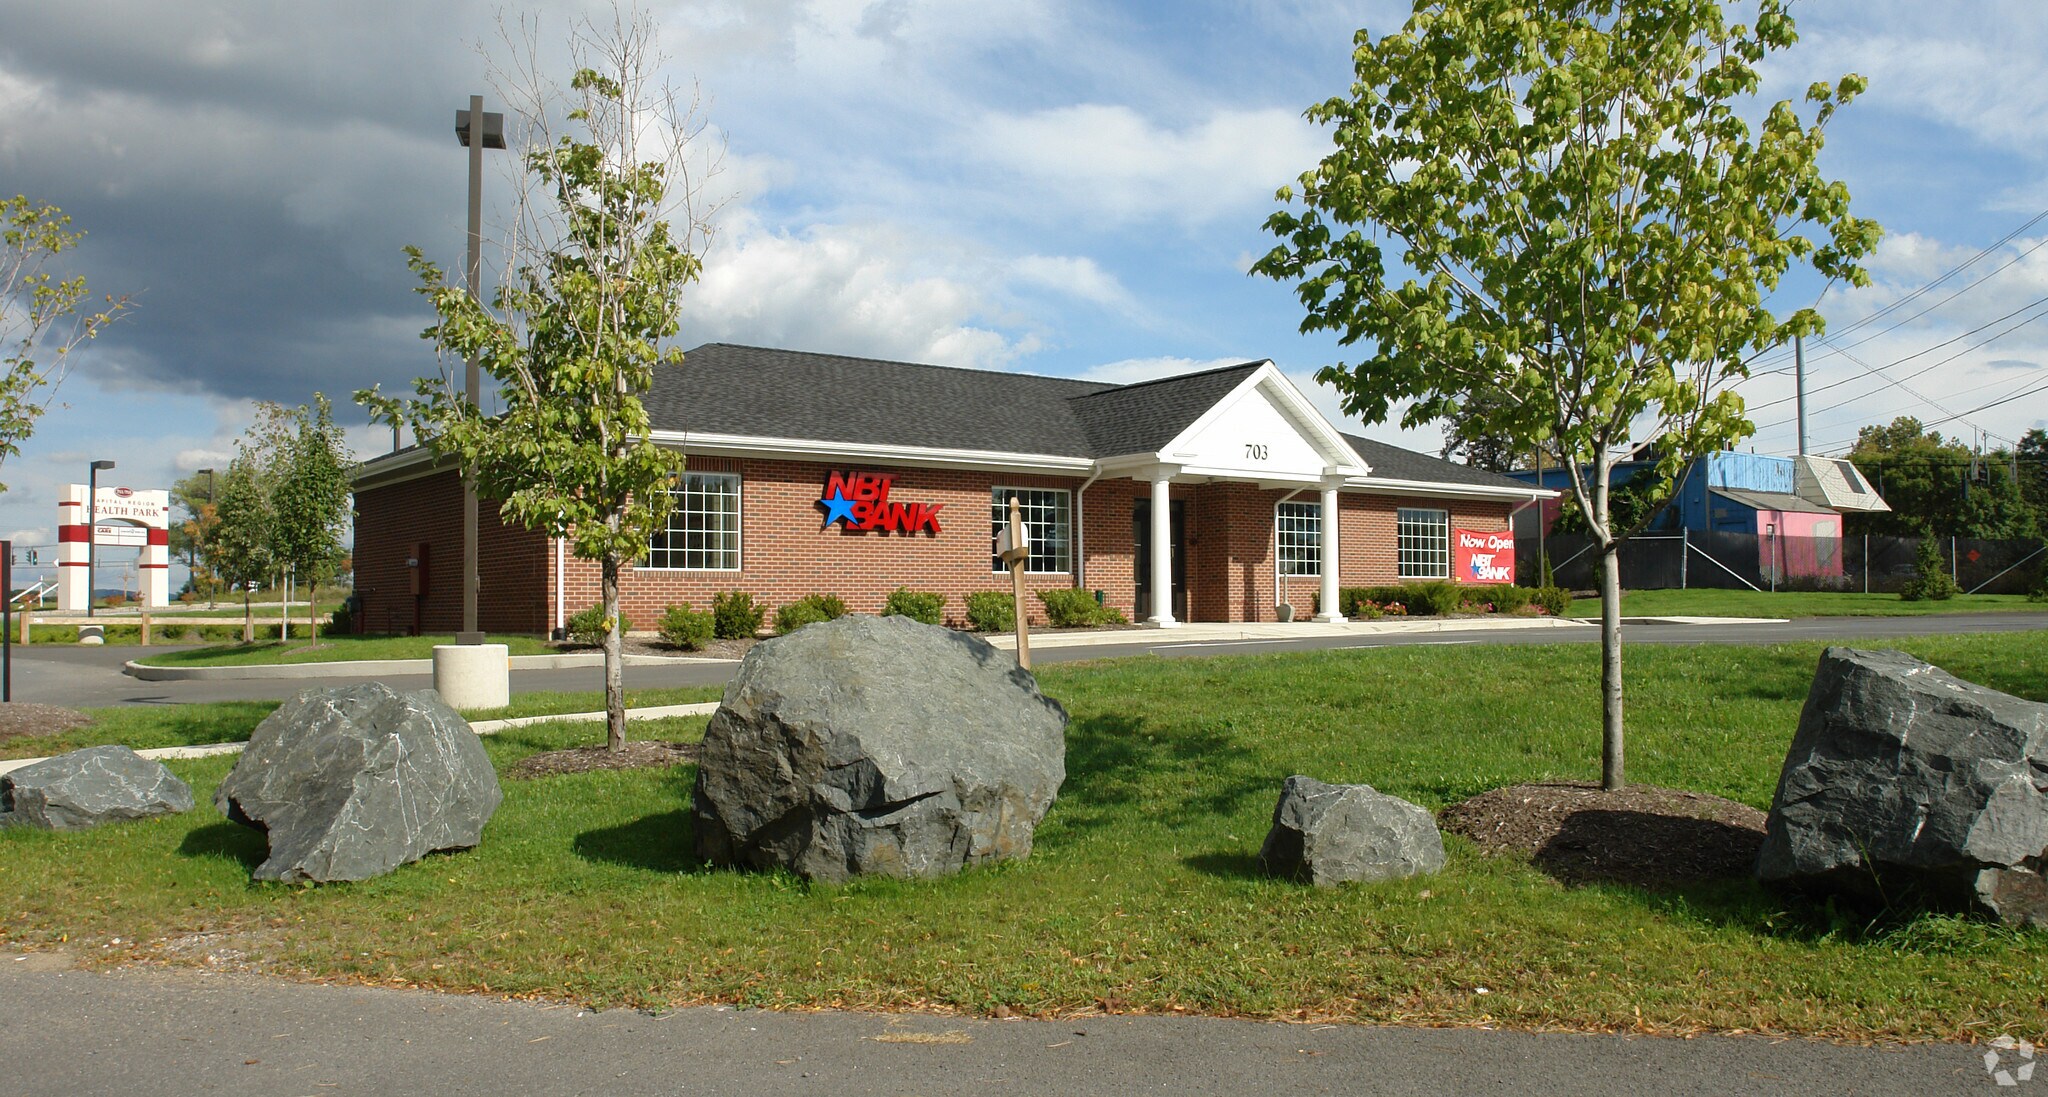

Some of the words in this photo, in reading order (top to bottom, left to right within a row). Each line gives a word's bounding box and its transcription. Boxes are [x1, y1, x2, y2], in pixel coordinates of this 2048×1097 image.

[1245, 444, 1268, 460] 703
[826, 471, 900, 500] NBT
[133, 507, 159, 517] PARK
[846, 501, 944, 532] BANK
[1460, 534, 1485, 548] Now
[1488, 535, 1514, 552] Open
[1470, 553, 1495, 567] NBT
[1477, 566, 1510, 580] BANK
